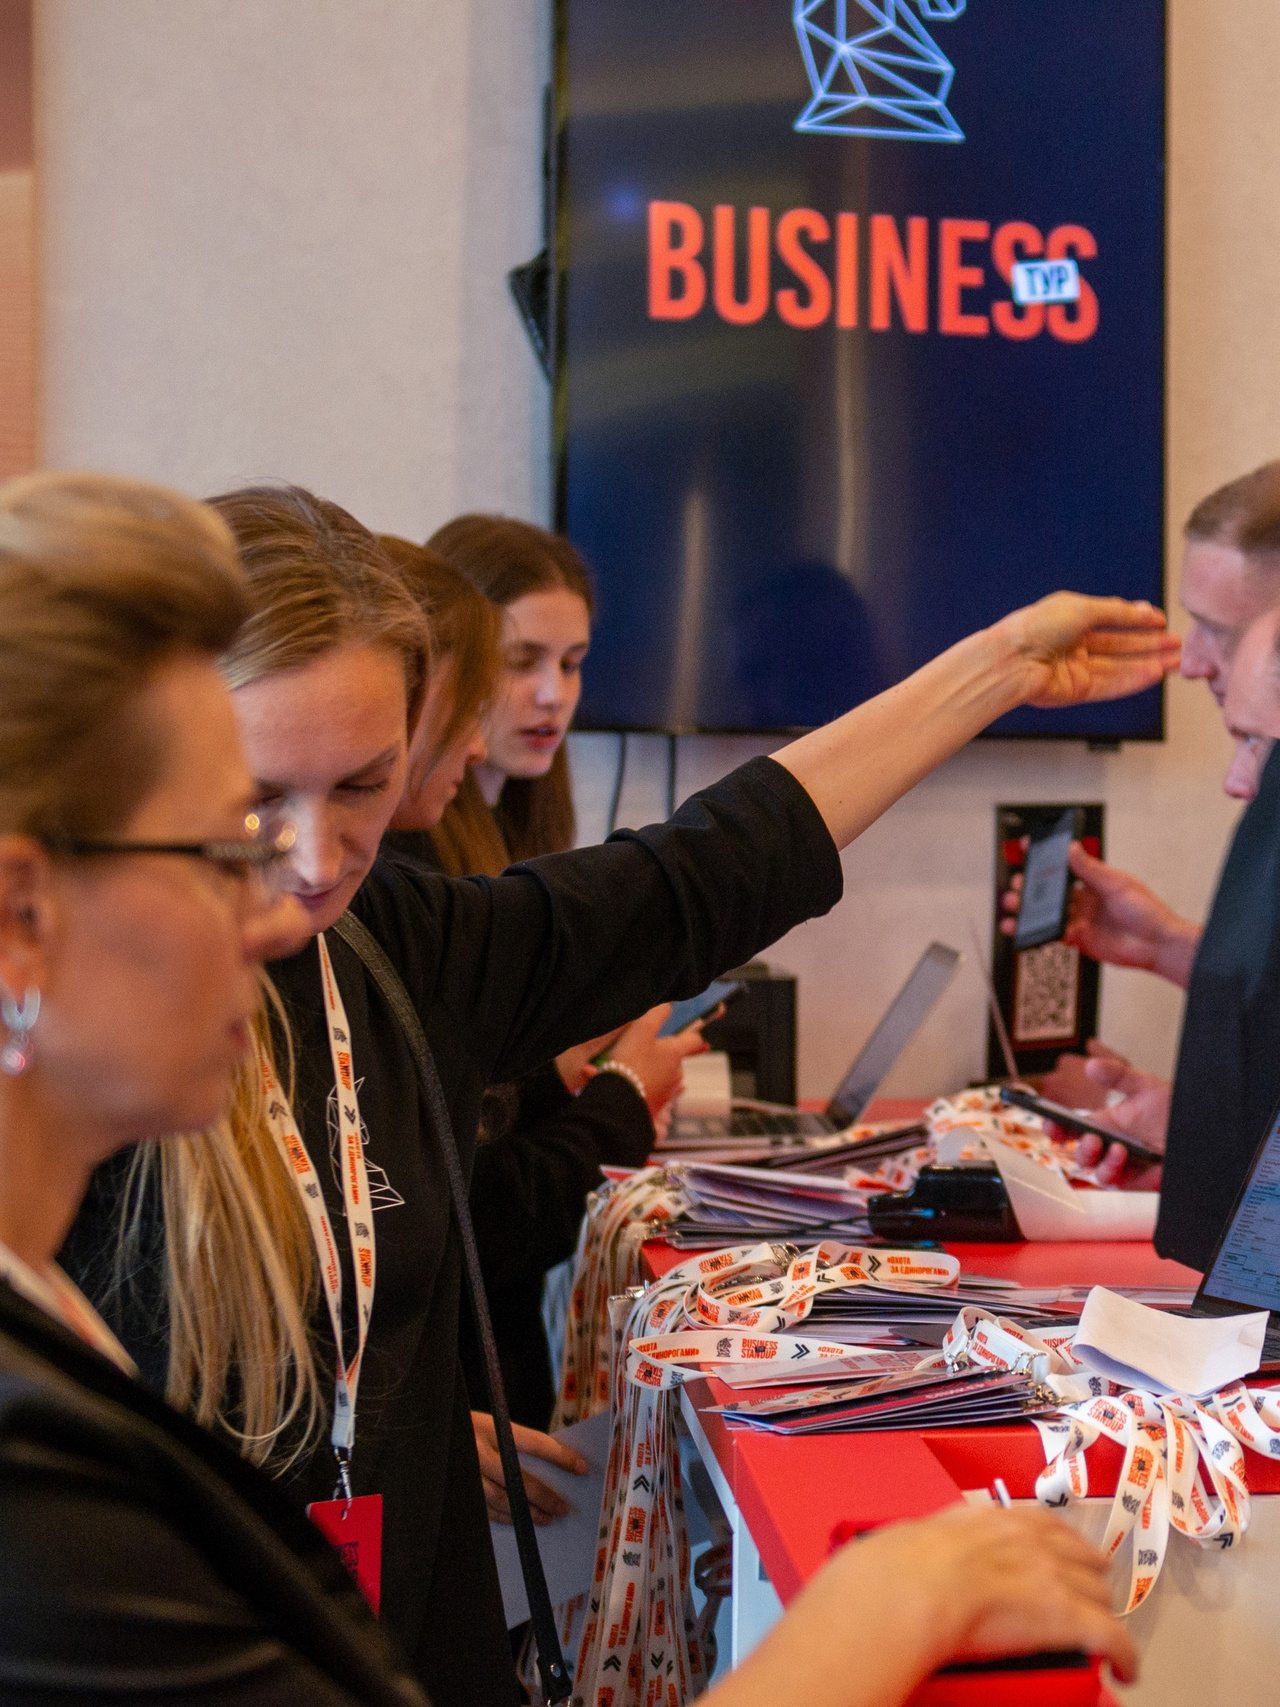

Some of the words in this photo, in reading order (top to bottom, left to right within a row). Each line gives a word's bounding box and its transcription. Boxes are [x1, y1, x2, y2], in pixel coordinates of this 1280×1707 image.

[647, 201, 1099, 343] BUSINESS
[1024, 265, 1070, 298] ТУР
[647, 1347, 700, 1361] ДИНОРОГАМИ»
[741, 1338, 779, 1351] BUSINESS
[741, 1348, 777, 1359] STANDUP
[1087, 1406, 1125, 1433] STANDUP
[1093, 1398, 1128, 1424] BUSINESS
